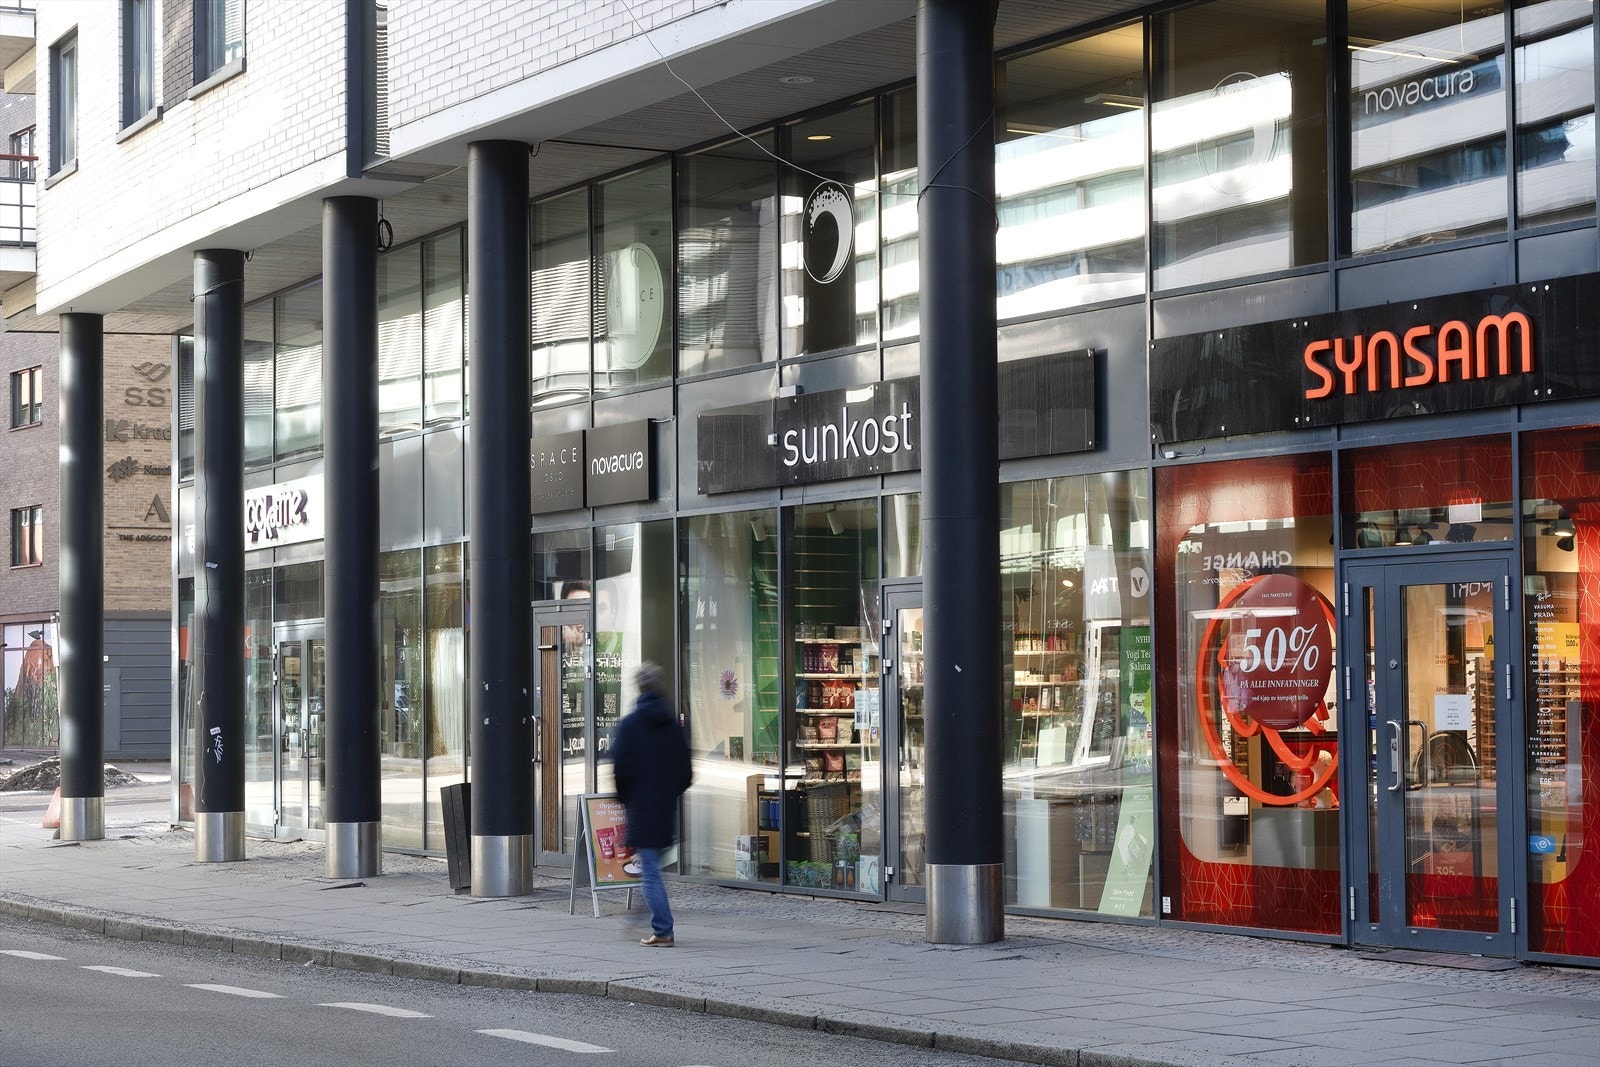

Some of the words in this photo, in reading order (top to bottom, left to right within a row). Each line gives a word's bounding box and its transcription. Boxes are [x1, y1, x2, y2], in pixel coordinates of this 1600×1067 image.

[1365, 68, 1475, 115] novacura
[1303, 311, 1535, 399] SYNSAM
[125, 387, 171, 407] SS
[783, 402, 912, 467] sunkost
[530, 447, 577, 469] SPACE
[591, 451, 644, 476] novacura
[1125, 649, 1139, 661] Yogi
[1240, 623, 1319, 674] 50%
[1240, 680, 1249, 688] PÅ
[1250, 680, 1267, 688] ALLE
[1267, 679, 1319, 688] INNFATNINGER
